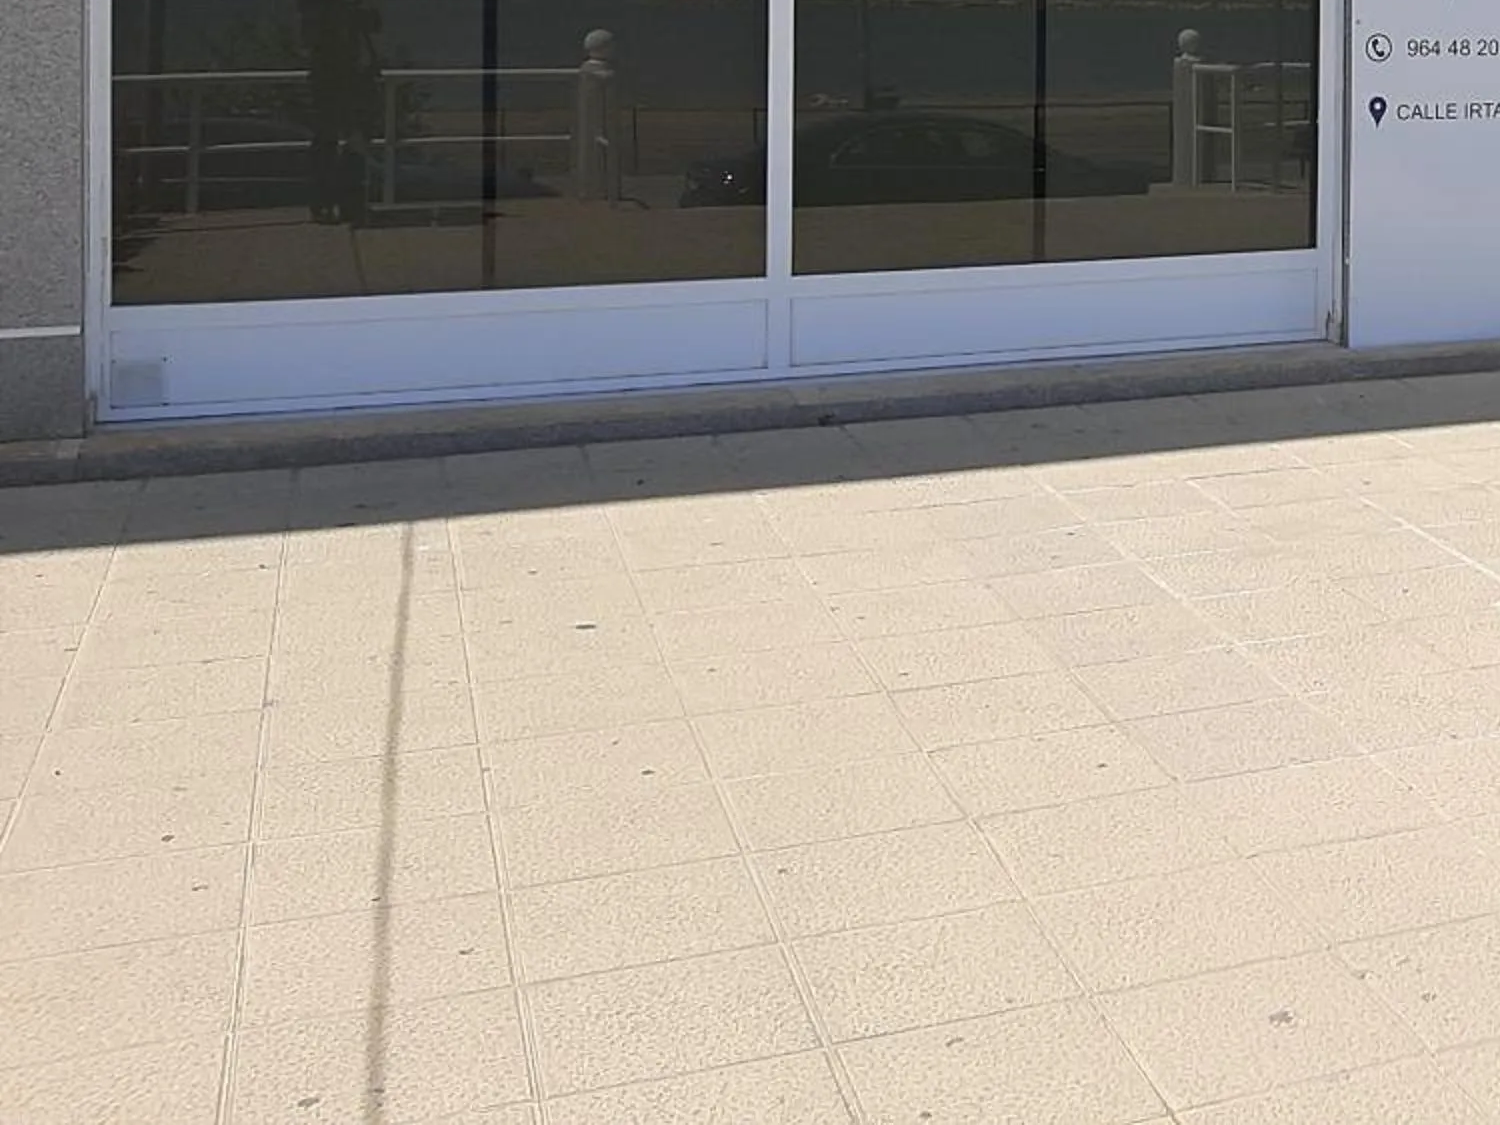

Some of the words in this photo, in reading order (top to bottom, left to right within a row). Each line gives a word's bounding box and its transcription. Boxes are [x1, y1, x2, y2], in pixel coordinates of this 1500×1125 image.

[1407, 39, 1441, 57] 964
[1448, 39, 1471, 56] 48
[1477, 39, 1499, 56] 20
[1397, 103, 1457, 120] CALLE
